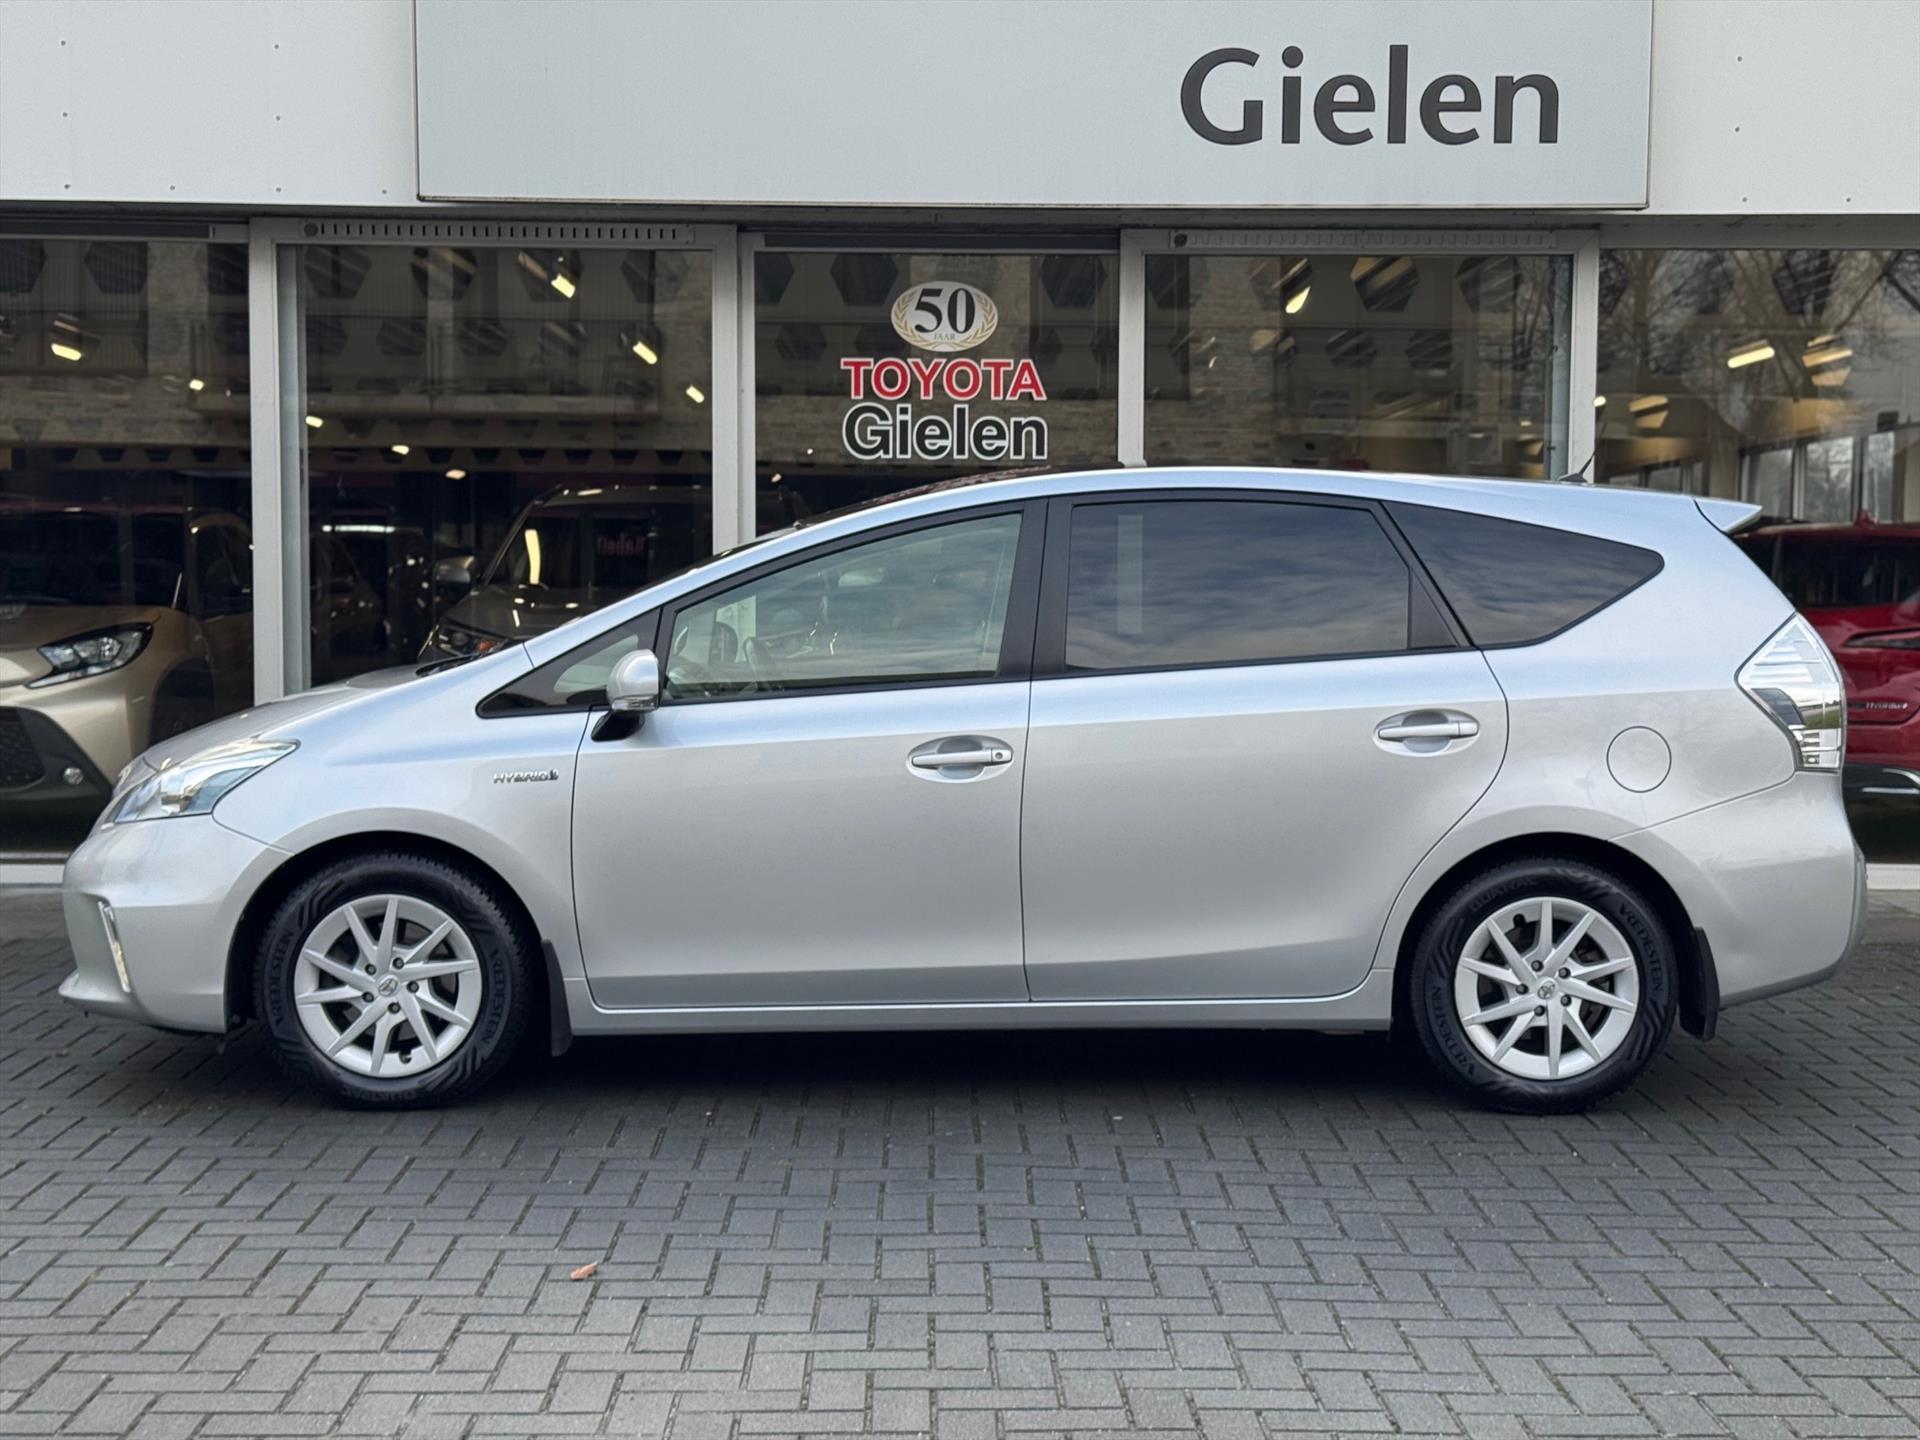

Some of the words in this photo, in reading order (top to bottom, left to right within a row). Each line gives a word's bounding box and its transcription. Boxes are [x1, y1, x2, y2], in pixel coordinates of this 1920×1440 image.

[1180, 44, 1559, 146] Gielen
[914, 287, 976, 334] 50
[933, 332, 956, 341] JAAR
[841, 357, 1047, 401] TOYOTA
[842, 402, 1048, 460] Gielen
[493, 770, 549, 784] HYBRID
[270, 930, 295, 1027] VREDESTEIN
[1617, 901, 1665, 993] VREDESTEIN
[483, 947, 507, 1046] VREDESTEIN
[1431, 985, 1477, 1078] VREDESTEIN
